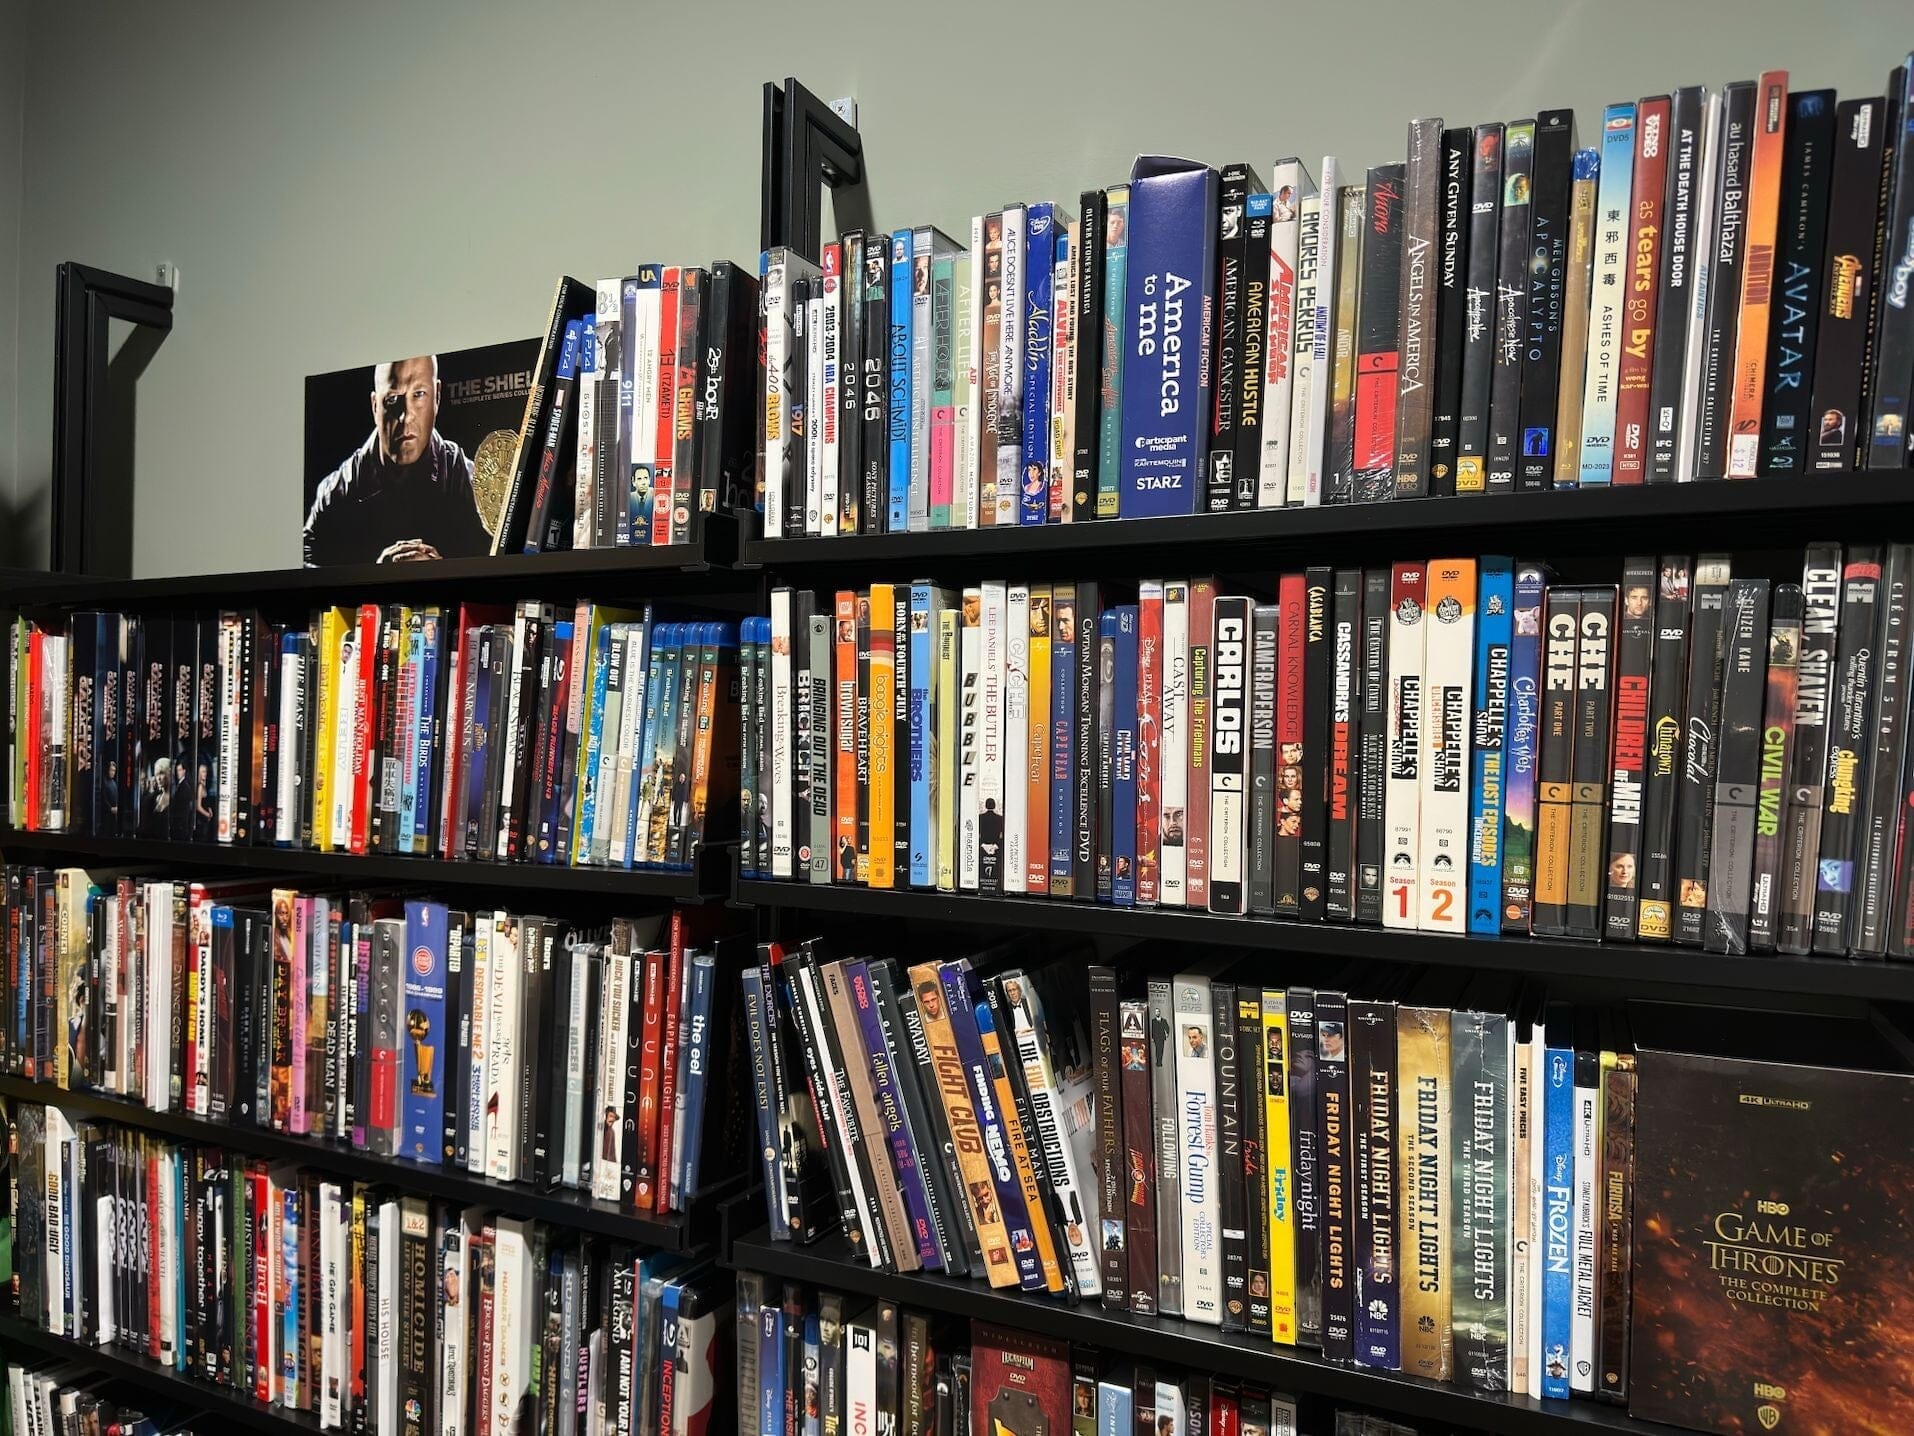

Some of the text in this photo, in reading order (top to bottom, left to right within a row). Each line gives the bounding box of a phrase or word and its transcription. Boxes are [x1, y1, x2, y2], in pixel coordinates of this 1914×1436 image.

[1443, 148, 1462, 289] ANY GIVEN SUNDAY
[1671, 129, 1692, 287] AT THE DEATH HOUSE DOOR
[1720, 122, 1741, 265] au hasard Balthazar
[1603, 209, 1621, 287] 東邪西毒
[1625, 201, 1657, 358] as tears go by
[1745, 244, 1772, 305] AUDITION
[1006, 296, 1014, 315] LIVE
[1138, 276, 1158, 357] to me
[1528, 217, 1550, 362] APOCALYPTO
[560, 341, 574, 371] PS4
[1005, 317, 1014, 342] HERE
[1025, 291, 1048, 372] Aladdin
[1161, 272, 1193, 418] America
[1200, 296, 1211, 388] AMERICAN FICTION
[1597, 306, 1612, 402] ASHES OF TIME
[1775, 261, 1812, 394] AVATAR
[447, 370, 533, 397] THE SHIEL
[824, 305, 837, 445] 2003-2004 NBA CHAMPIONS
[844, 363, 855, 410] 2046
[865, 358, 881, 421] 2046
[891, 324, 906, 444] ABOUT SCHMIDT
[969, 368, 977, 385] AIR
[1004, 345, 1013, 395] ANYMORE
[545, 408, 562, 449] SPIDER-MAN
[791, 404, 804, 437] 1917
[1137, 477, 1182, 491] STARZ
[1308, 585, 1326, 643] CASABLANCA
[1737, 598, 1754, 673] CITIZEN KANE
[1792, 568, 1837, 727] CLEAN SHAVEN
[609, 642, 621, 688] BLOW OUT
[1547, 613, 1575, 691] CHE
[1579, 611, 1608, 690] CHE
[1885, 639, 1899, 684] FROM
[986, 674, 998, 698] THE
[1192, 648, 1206, 769] Capturing the Friedmans
[1215, 618, 1243, 755] CARLOS
[1252, 630, 1275, 749] CAMERAPERSON
[1490, 646, 1508, 748] CHAPPELLE'S
[1552, 702, 1564, 737] PART ONE
[419, 714, 432, 768] THE BIRDS
[813, 677, 826, 817] BRINGING OUT THE DEAD
[857, 697, 868, 785] BRAVEHEART
[963, 672, 978, 786] BUBBLE
[985, 700, 998, 763] BUTLER
[1078, 618, 1094, 862] CAPTAIN MORGAN TRAINING EXCELLENCE DVD
[1391, 742, 1403, 775] SHOW
[1401, 679, 1420, 777] CHAPPELLE'S
[1476, 710, 1489, 747] SHOW
[1612, 675, 1648, 825] CHILDREN OF MEN
[1652, 716, 1679, 778] Chinatown
[1686, 717, 1711, 785] Chocolat
[1332, 723, 1350, 820] DREAM
[1757, 726, 1786, 836] CIVIL WAR
[1829, 746, 1840, 781] express
[1829, 749, 1854, 814] chungking
[814, 860, 824, 870] 47
[965, 831, 973, 872] magnolia
[1389, 876, 1416, 885] Season
[1394, 886, 1407, 918] 1
[1640, 924, 1668, 933] DVD
[690, 1015, 705, 1075] the eel
[748, 993, 769, 1111] EVIL DOES NOT EXIST
[933, 1045, 983, 1155] FIGHT CLUB
[972, 1065, 1012, 1183] FINDING NEMO
[1219, 1034, 1239, 1157] FOUNTAIN
[1740, 1095, 1763, 1105] 4K
[1161, 1117, 1177, 1180] FOLLOWING
[1185, 1090, 1207, 1204] Forrest Gump
[1324, 1091, 1343, 1290] FRIDAY NIGHT LIGHTS
[1416, 1076, 1439, 1293] FRIDAY NIGHT LIGHTS
[1757, 1200, 1790, 1216] HBO
[1547, 1185, 1571, 1275] FROZEN
[1702, 1240, 1845, 1284] THRONES
[1714, 1212, 1834, 1248] GAME OF
[257, 1256, 268, 1304] HITCH
[1577, 1230, 1593, 1319] FULL METAL JACKET
[1719, 1276, 1828, 1300] THE COMPLETE
[1726, 1289, 1820, 1312] COLLECTION
[381, 1298, 389, 1361] HIS HOUSE
[412, 1243, 426, 1374] HOMICIDE
[854, 1334, 867, 1347] 101
[578, 1347, 588, 1414] HUSTLERS
[1753, 1383, 1786, 1399] HBO
